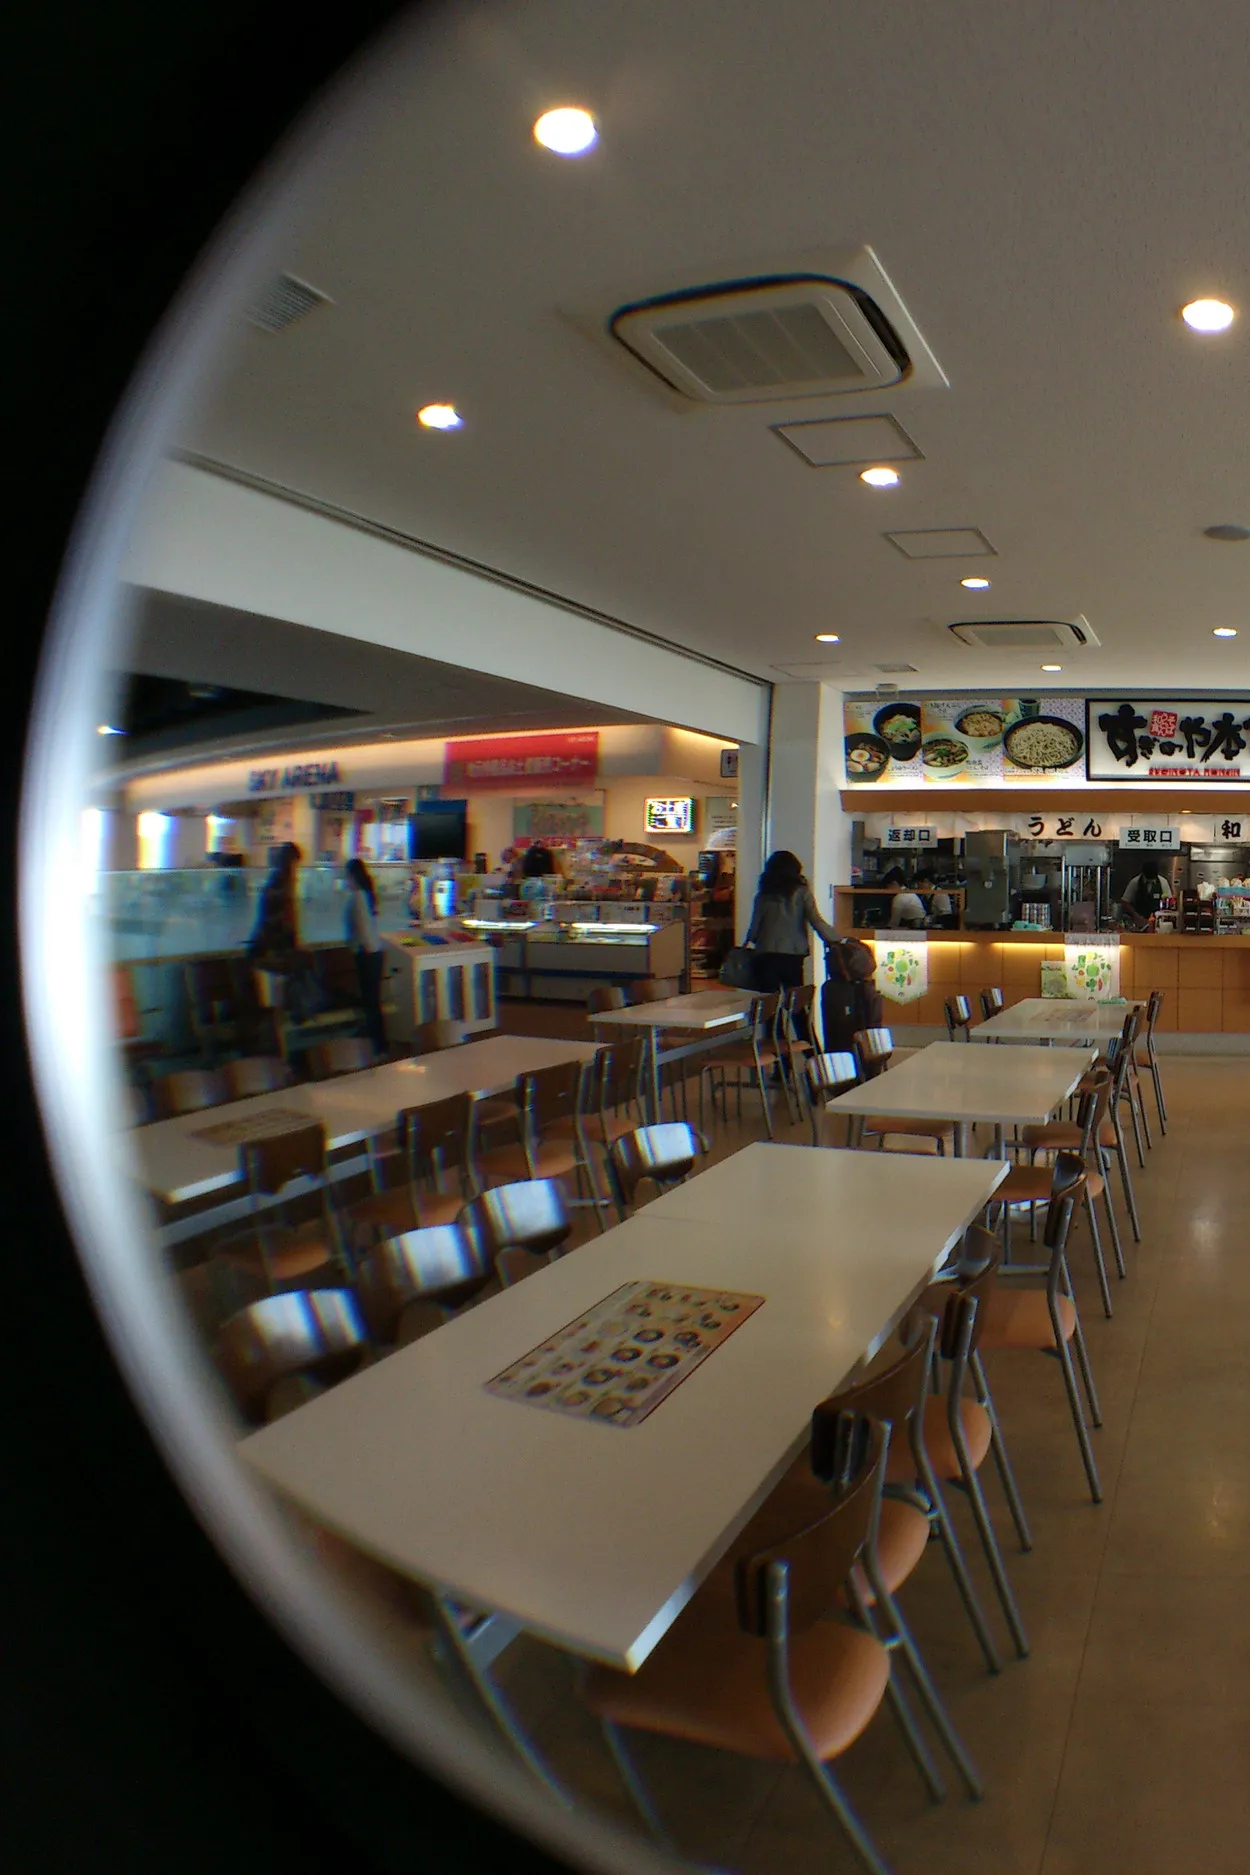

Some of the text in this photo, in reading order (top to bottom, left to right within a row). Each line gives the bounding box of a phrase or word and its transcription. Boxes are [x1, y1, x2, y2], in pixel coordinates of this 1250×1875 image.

[1028, 816, 1102, 838] うどん
[888, 829, 930, 842] 返却口
[1128, 829, 1172, 843] 受取口
